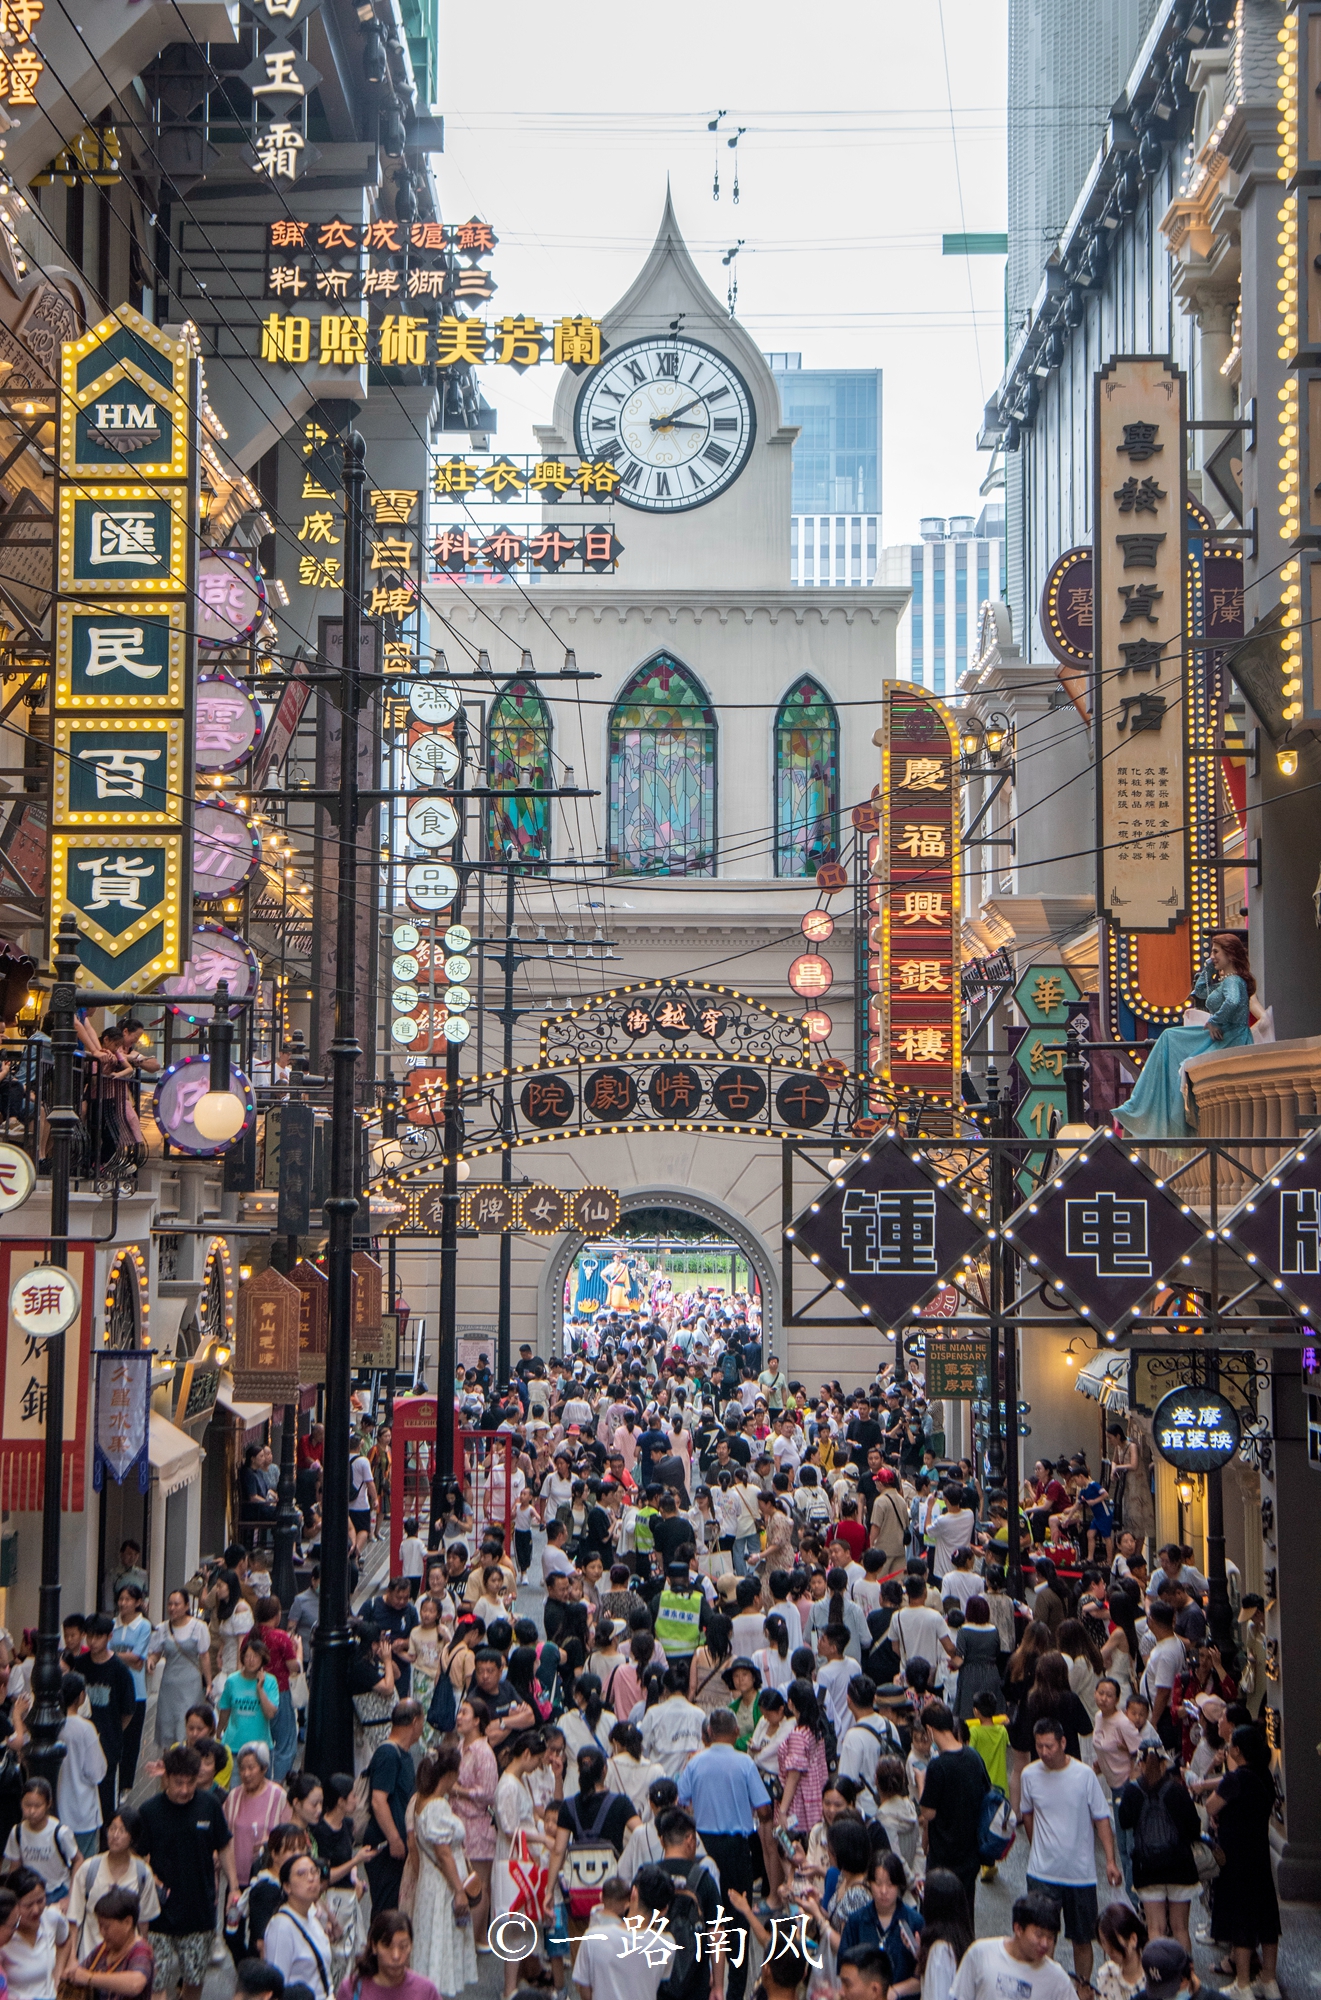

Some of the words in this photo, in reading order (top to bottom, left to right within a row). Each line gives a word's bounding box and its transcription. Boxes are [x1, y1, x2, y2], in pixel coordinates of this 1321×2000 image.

[95, 404, 157, 428] HM
[77, 512, 163, 911] 匯民百貨
[415, 681, 452, 896] 鴻運食品
[897, 757, 949, 1063] 慶福興銀樓
[395, 928, 415, 1038] 上海味道
[447, 929, 467, 1037] 傳統風味
[626, 1002, 724, 1035] 穿越街
[528, 1072, 824, 1119] 千古情劇院
[930, 1343, 946, 1351] THE
[949, 1343, 972, 1351] NIAN
[975, 1343, 986, 1351] HE
[930, 1352, 987, 1360] DISPENSARY
